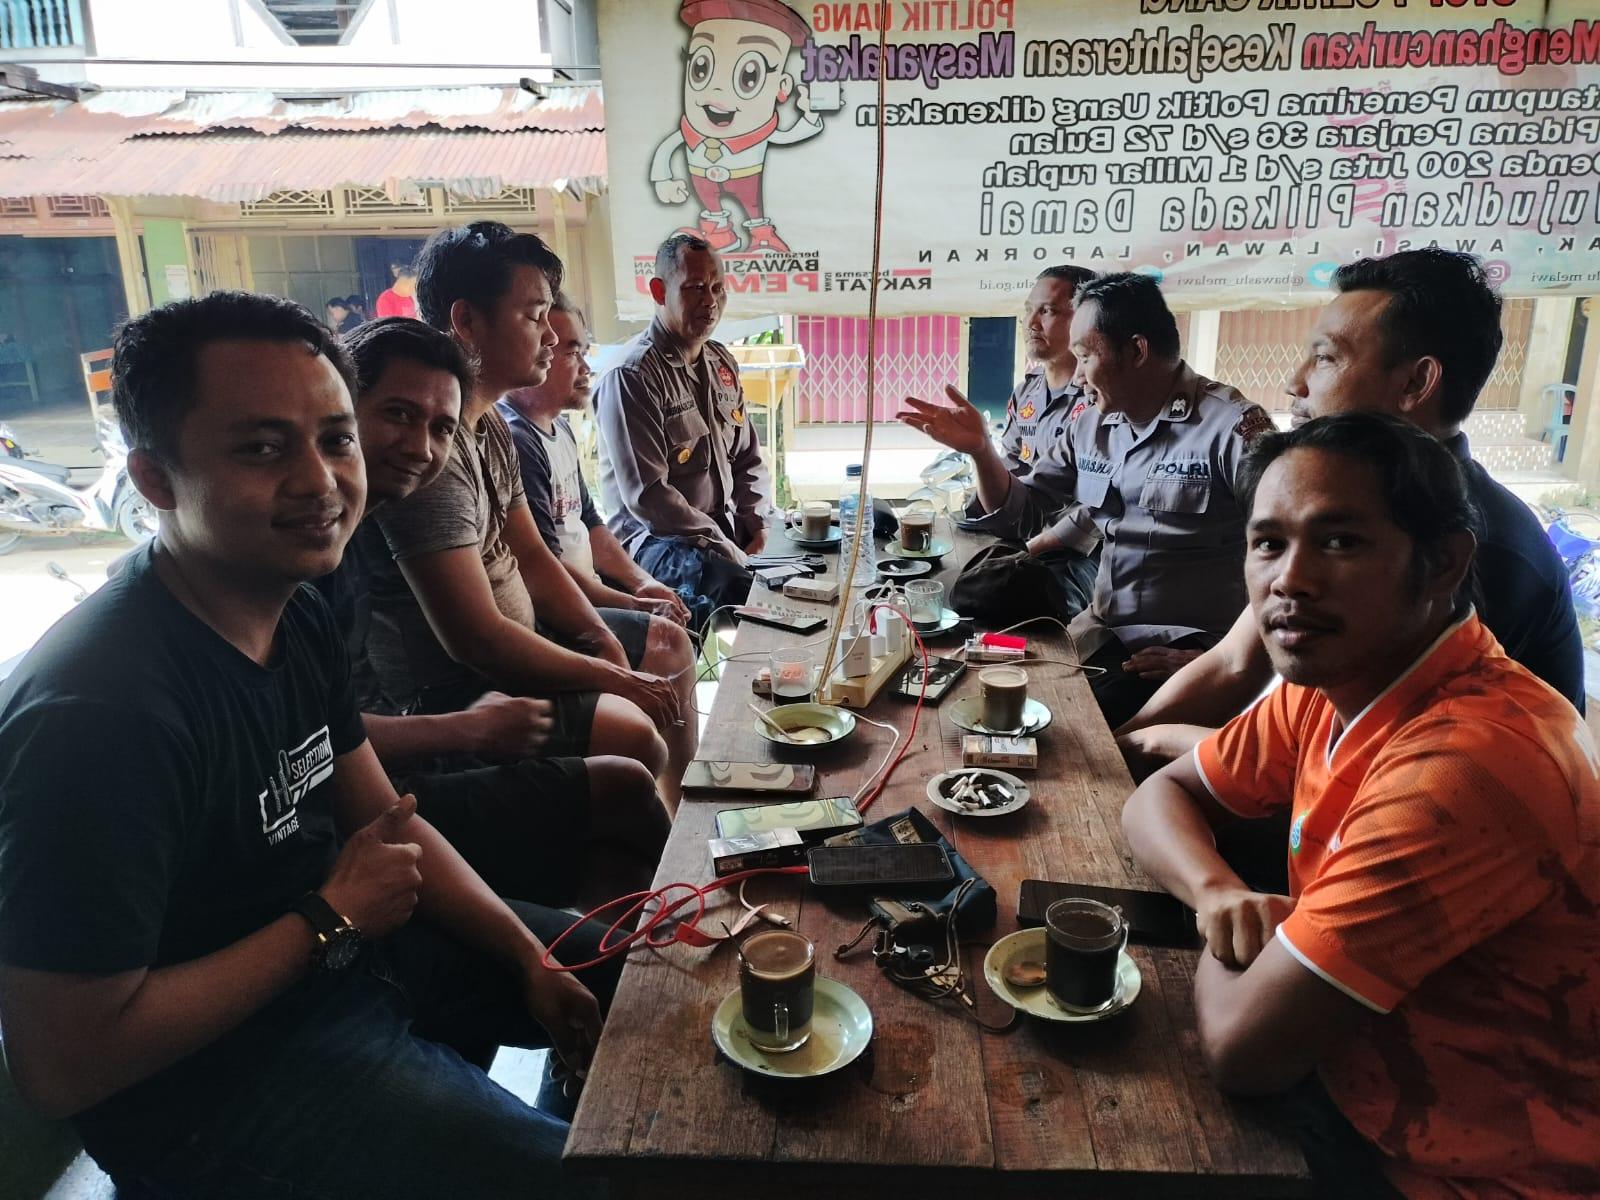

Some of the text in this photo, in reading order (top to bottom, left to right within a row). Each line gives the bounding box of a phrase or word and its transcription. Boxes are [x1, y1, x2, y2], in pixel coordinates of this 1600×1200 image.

[1153, 461, 1210, 476] POLRI
[291, 739, 331, 780] SELECTION
[268, 815, 300, 847] VINTAGE
